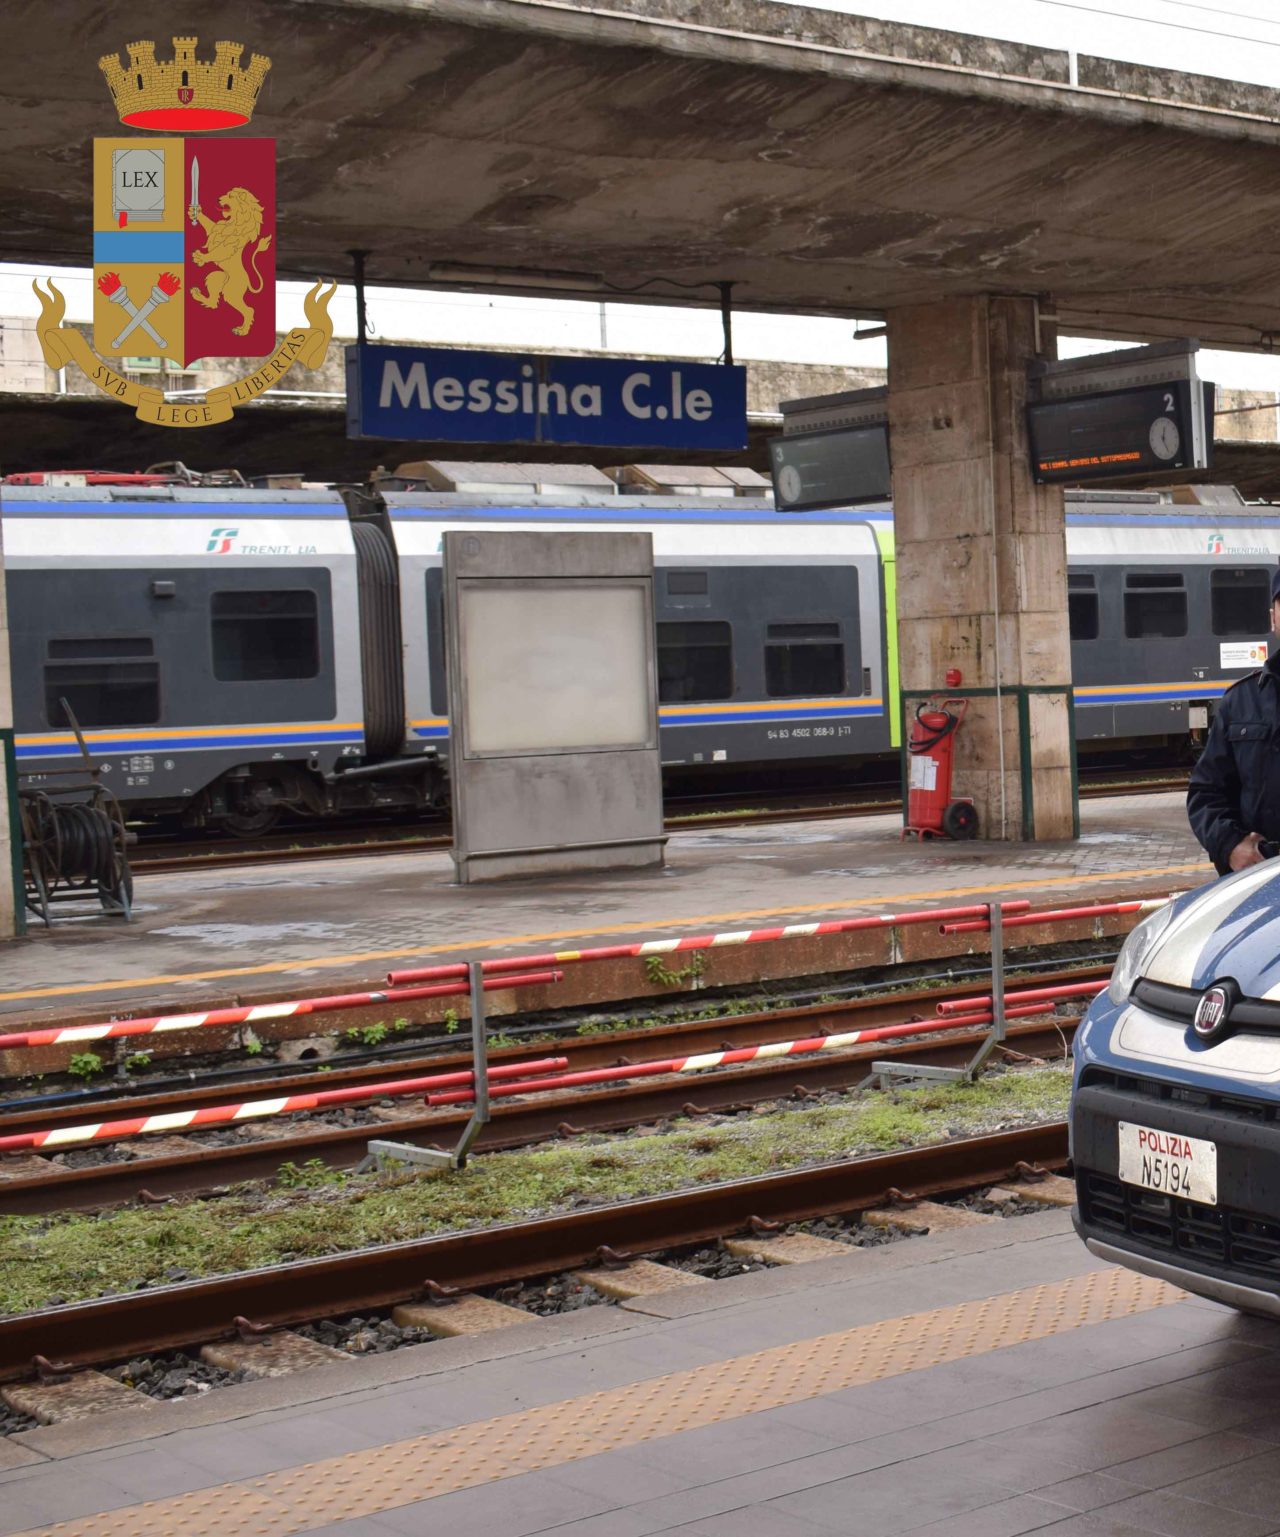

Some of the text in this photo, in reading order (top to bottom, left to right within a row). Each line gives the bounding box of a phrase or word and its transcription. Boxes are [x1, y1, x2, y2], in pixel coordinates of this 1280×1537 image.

[378, 359, 713, 421] Messina C.le
[1163, 393, 1176, 412] 2
[775, 447, 785, 462] 3
[240, 545, 318, 554] TRENITLIA
[1201, 1001, 1221, 1022] FIAT
[1138, 1129, 1193, 1161] POLIZIA
[1141, 1155, 1191, 1197] N5194
